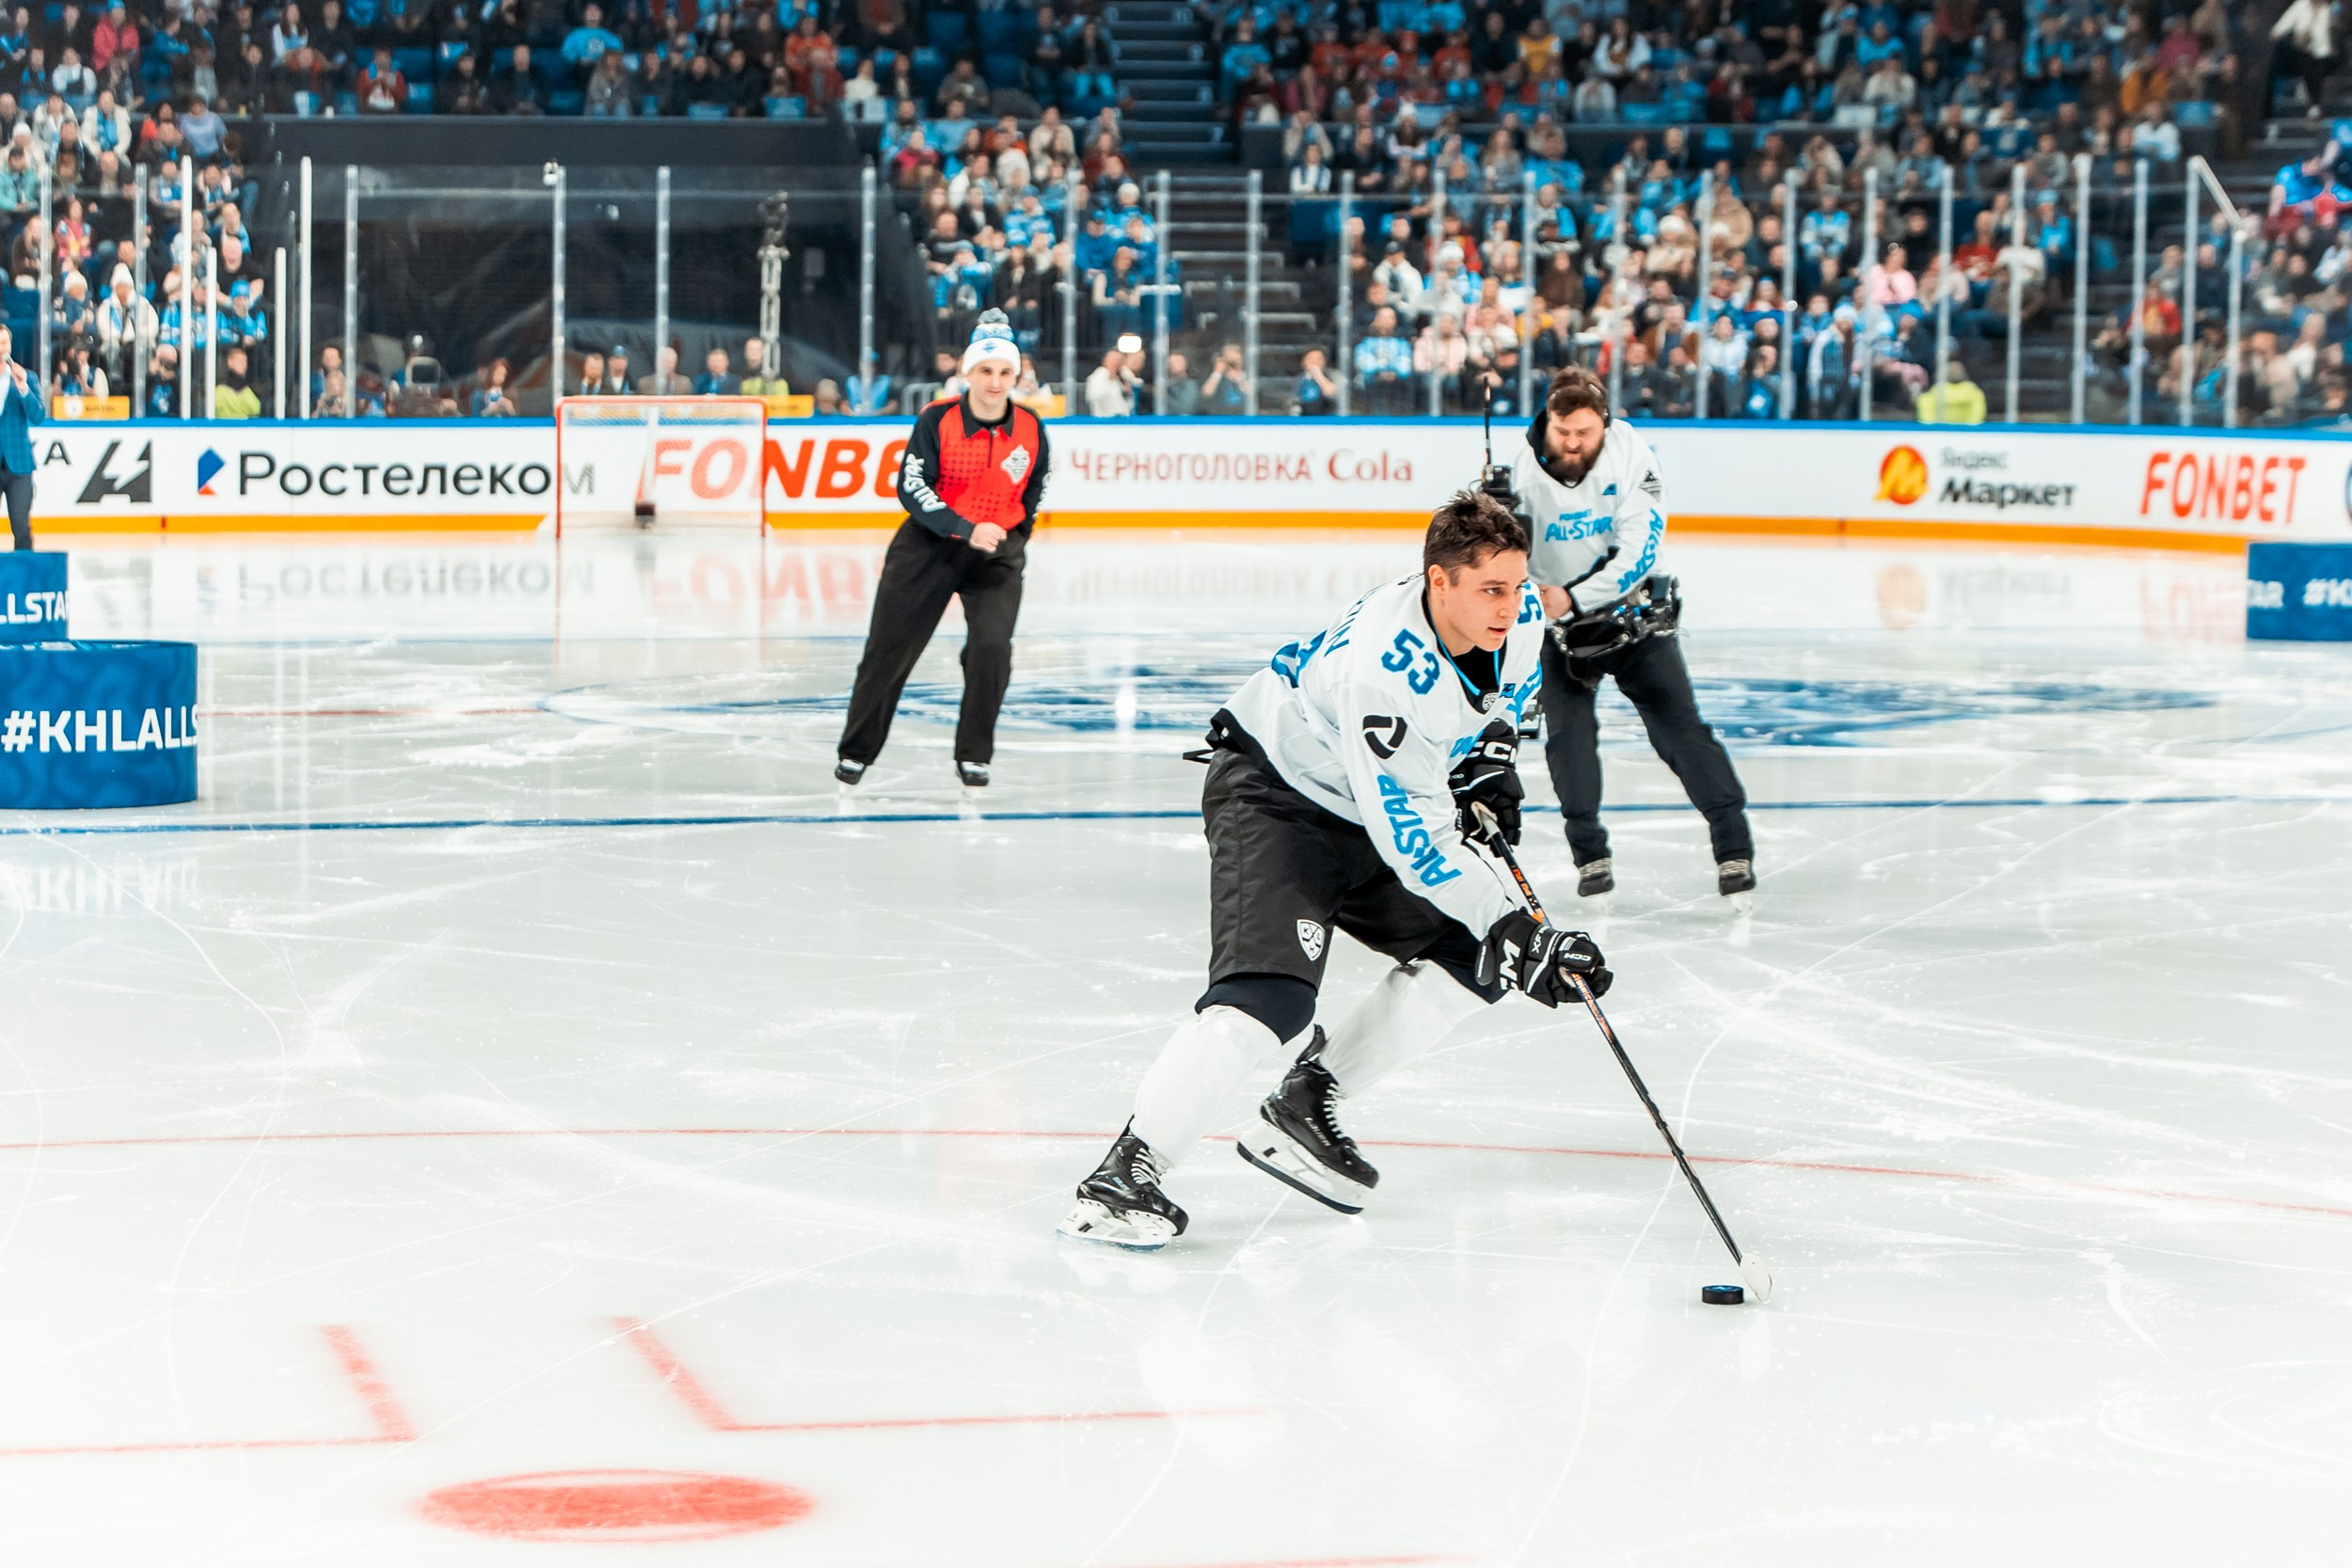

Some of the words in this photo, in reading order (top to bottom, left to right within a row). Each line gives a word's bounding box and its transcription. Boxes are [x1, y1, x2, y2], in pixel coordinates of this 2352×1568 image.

[239, 451, 596, 497] Ростелеком
[636, 437, 909, 500] FONBE
[1327, 448, 1413, 482] Cola
[2140, 451, 2306, 524] FONBET
[1939, 477, 2077, 509] Маркет
[0, 590, 68, 625] LSTA
[1380, 627, 1440, 695] 53
